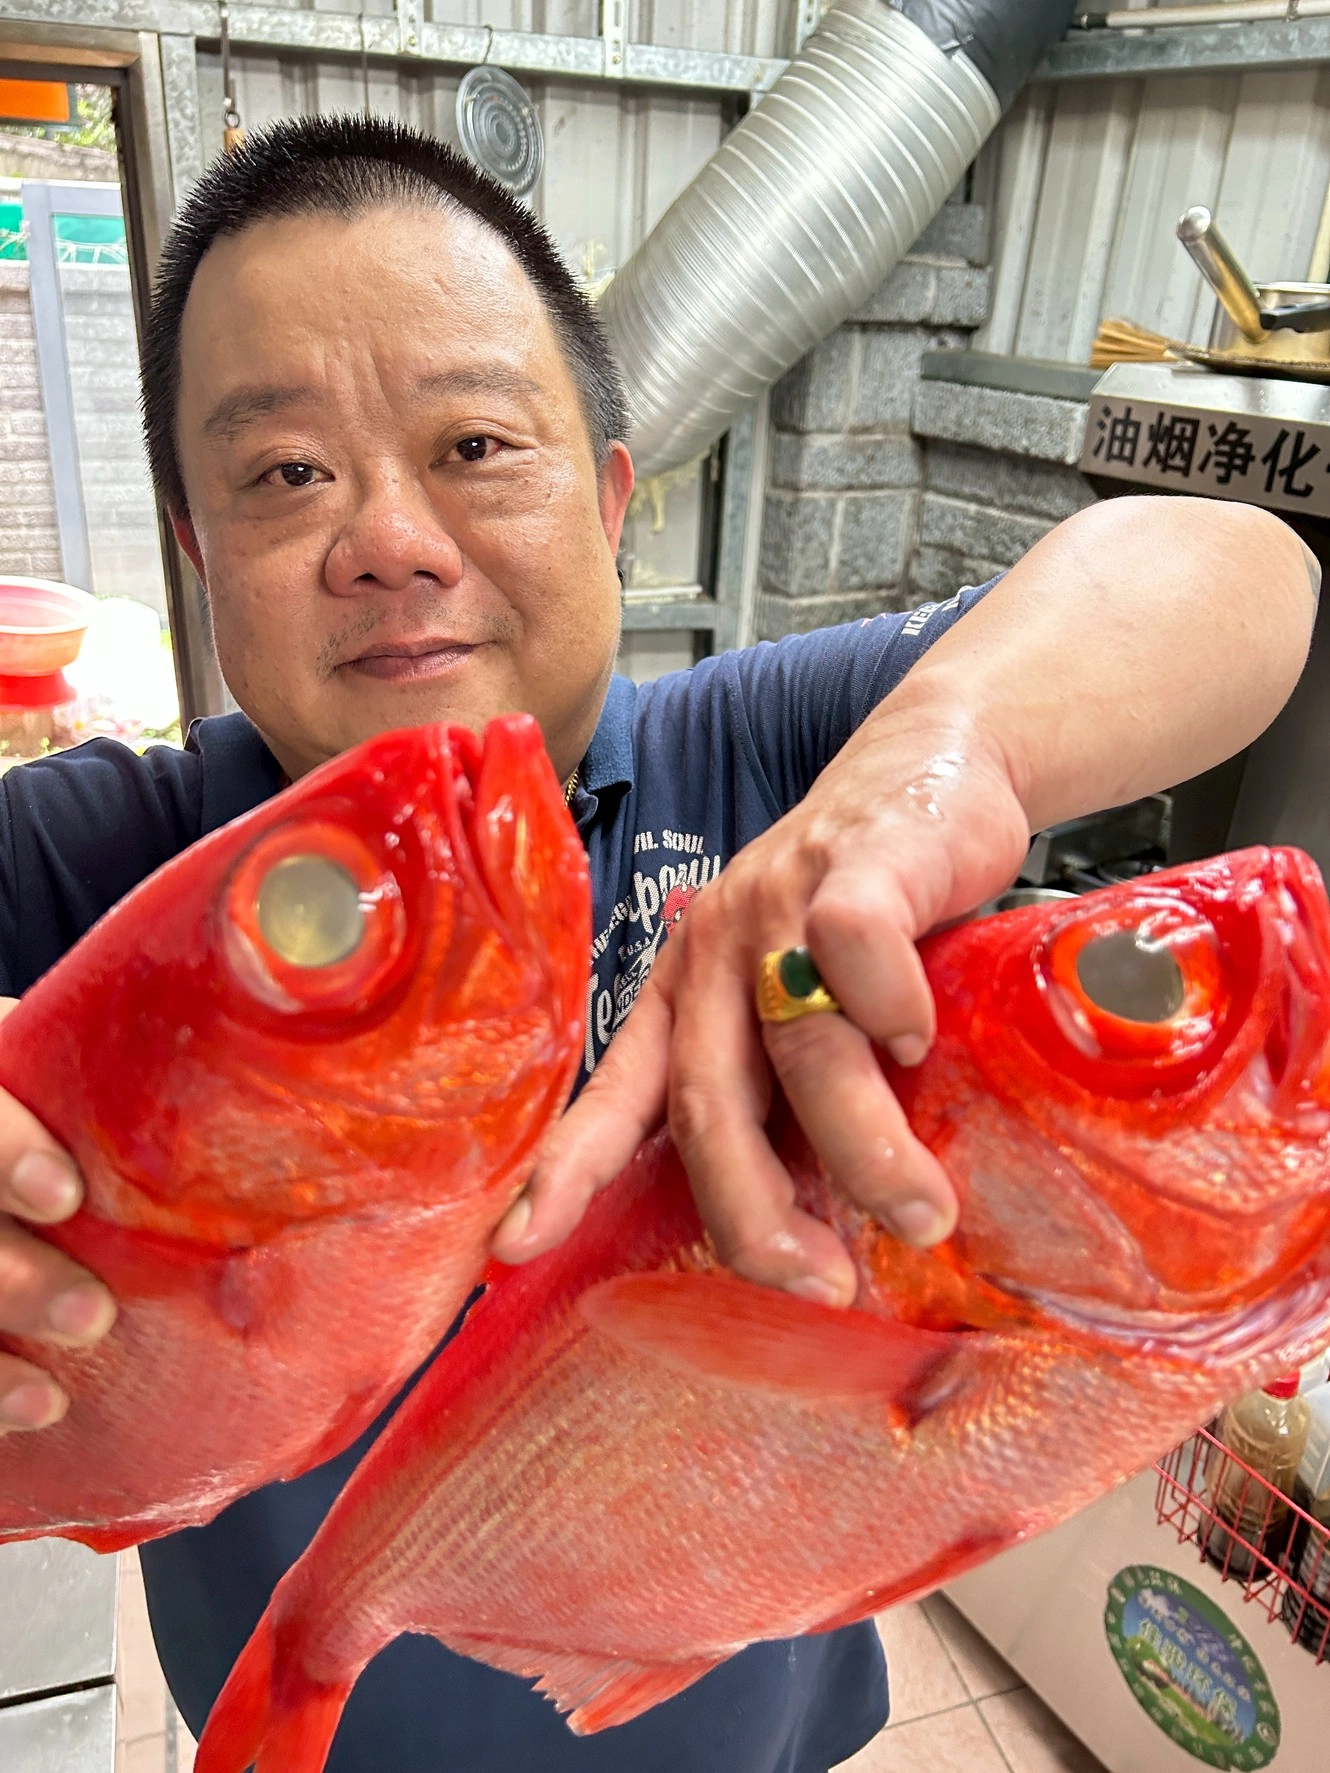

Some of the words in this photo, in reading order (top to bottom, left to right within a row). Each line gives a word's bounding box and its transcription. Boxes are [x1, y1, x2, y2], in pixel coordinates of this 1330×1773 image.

[1092, 404, 1330, 498] 油烟净化
[662, 829, 704, 855] SOUL
